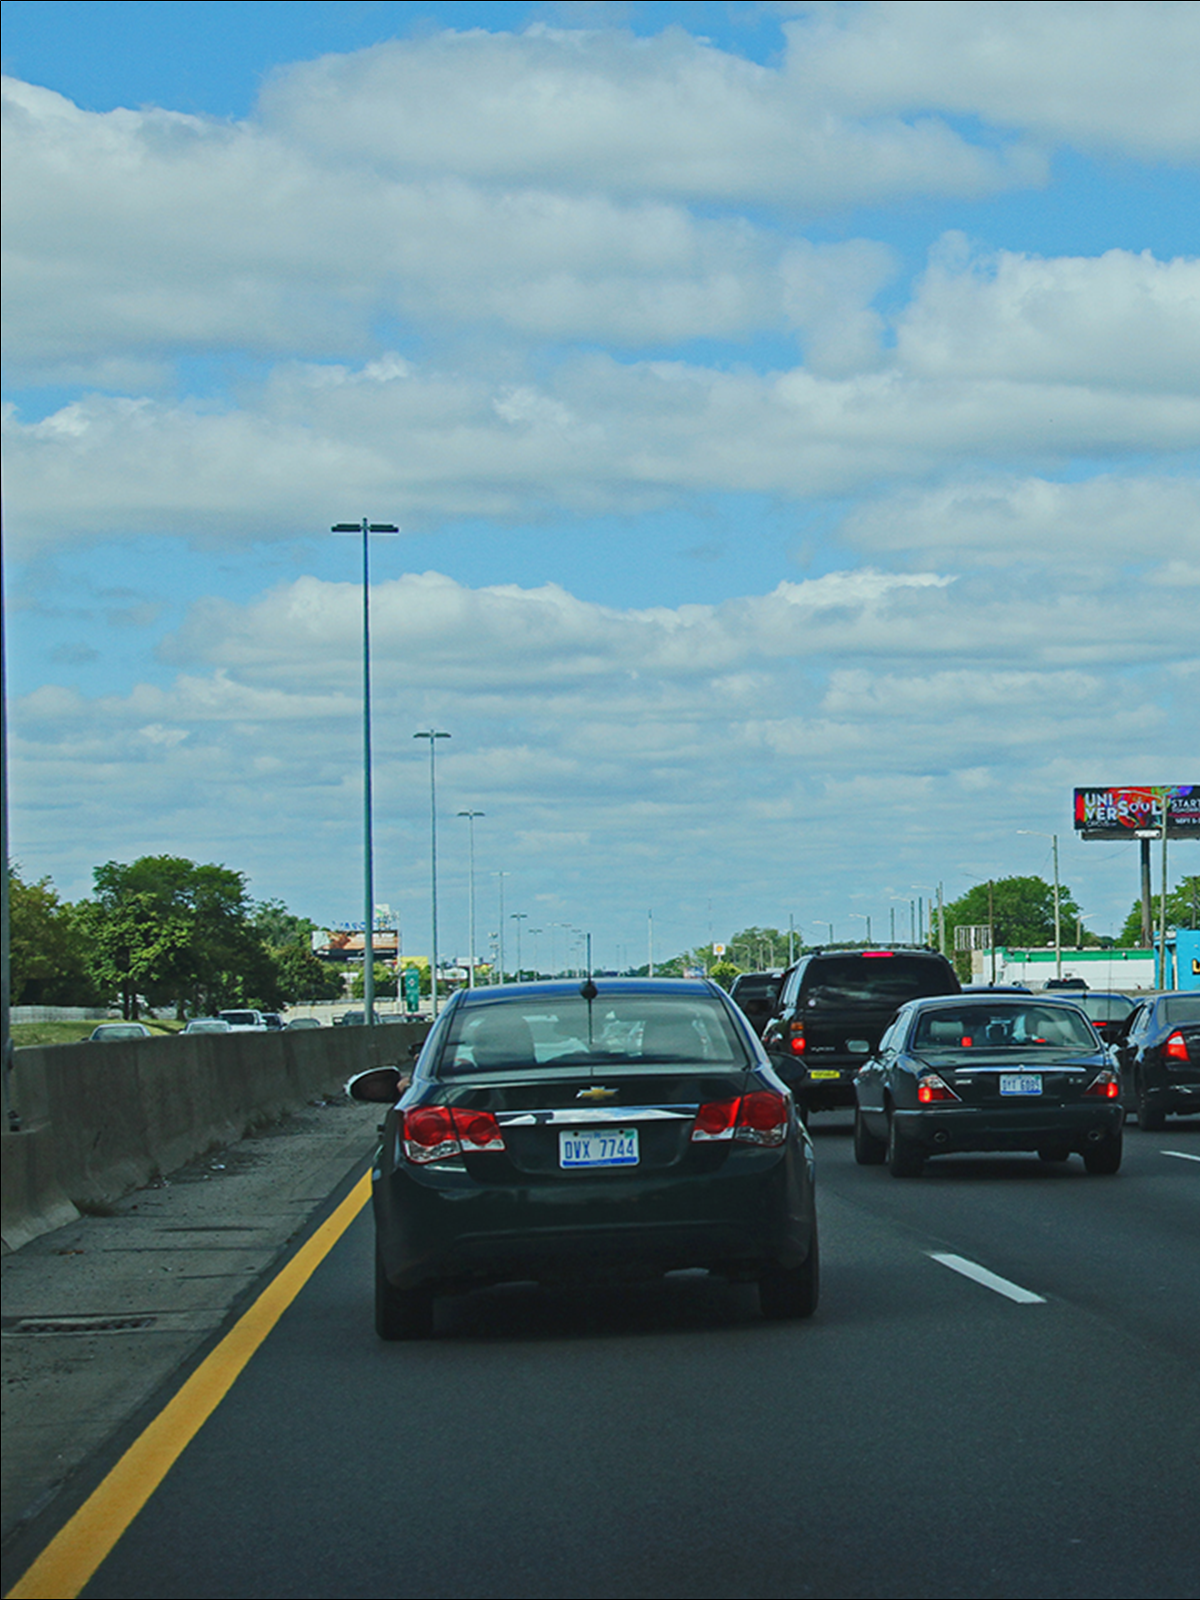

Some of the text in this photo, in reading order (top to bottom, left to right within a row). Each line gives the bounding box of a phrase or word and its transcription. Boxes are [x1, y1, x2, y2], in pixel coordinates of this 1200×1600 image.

[1084, 793, 1114, 807] UNI
[565, 1139, 634, 1159] DVX 7744
